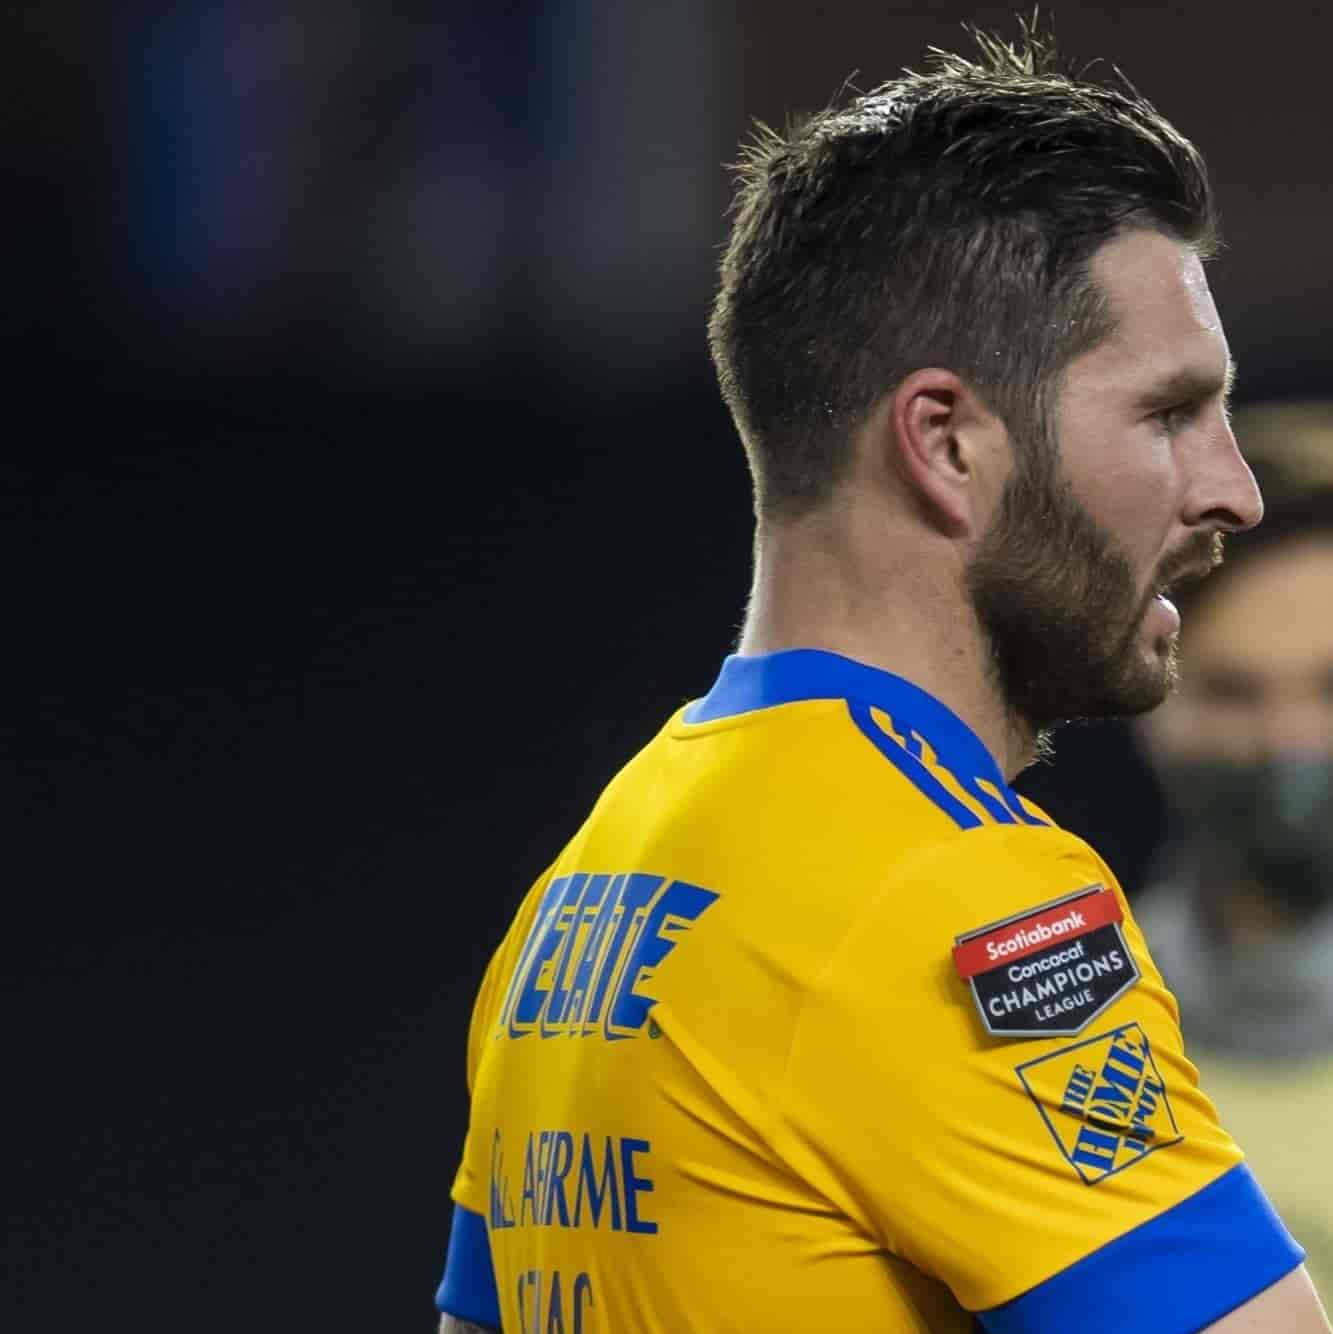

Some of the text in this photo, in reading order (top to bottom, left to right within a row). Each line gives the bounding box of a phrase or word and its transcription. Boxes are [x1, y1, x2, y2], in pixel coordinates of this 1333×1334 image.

[986, 911, 1087, 960] Scotiabank
[989, 951, 1124, 1016] CHAMPIONS
[1008, 941, 1084, 982] Concacaf
[1035, 989, 1095, 1021] LEAGUE
